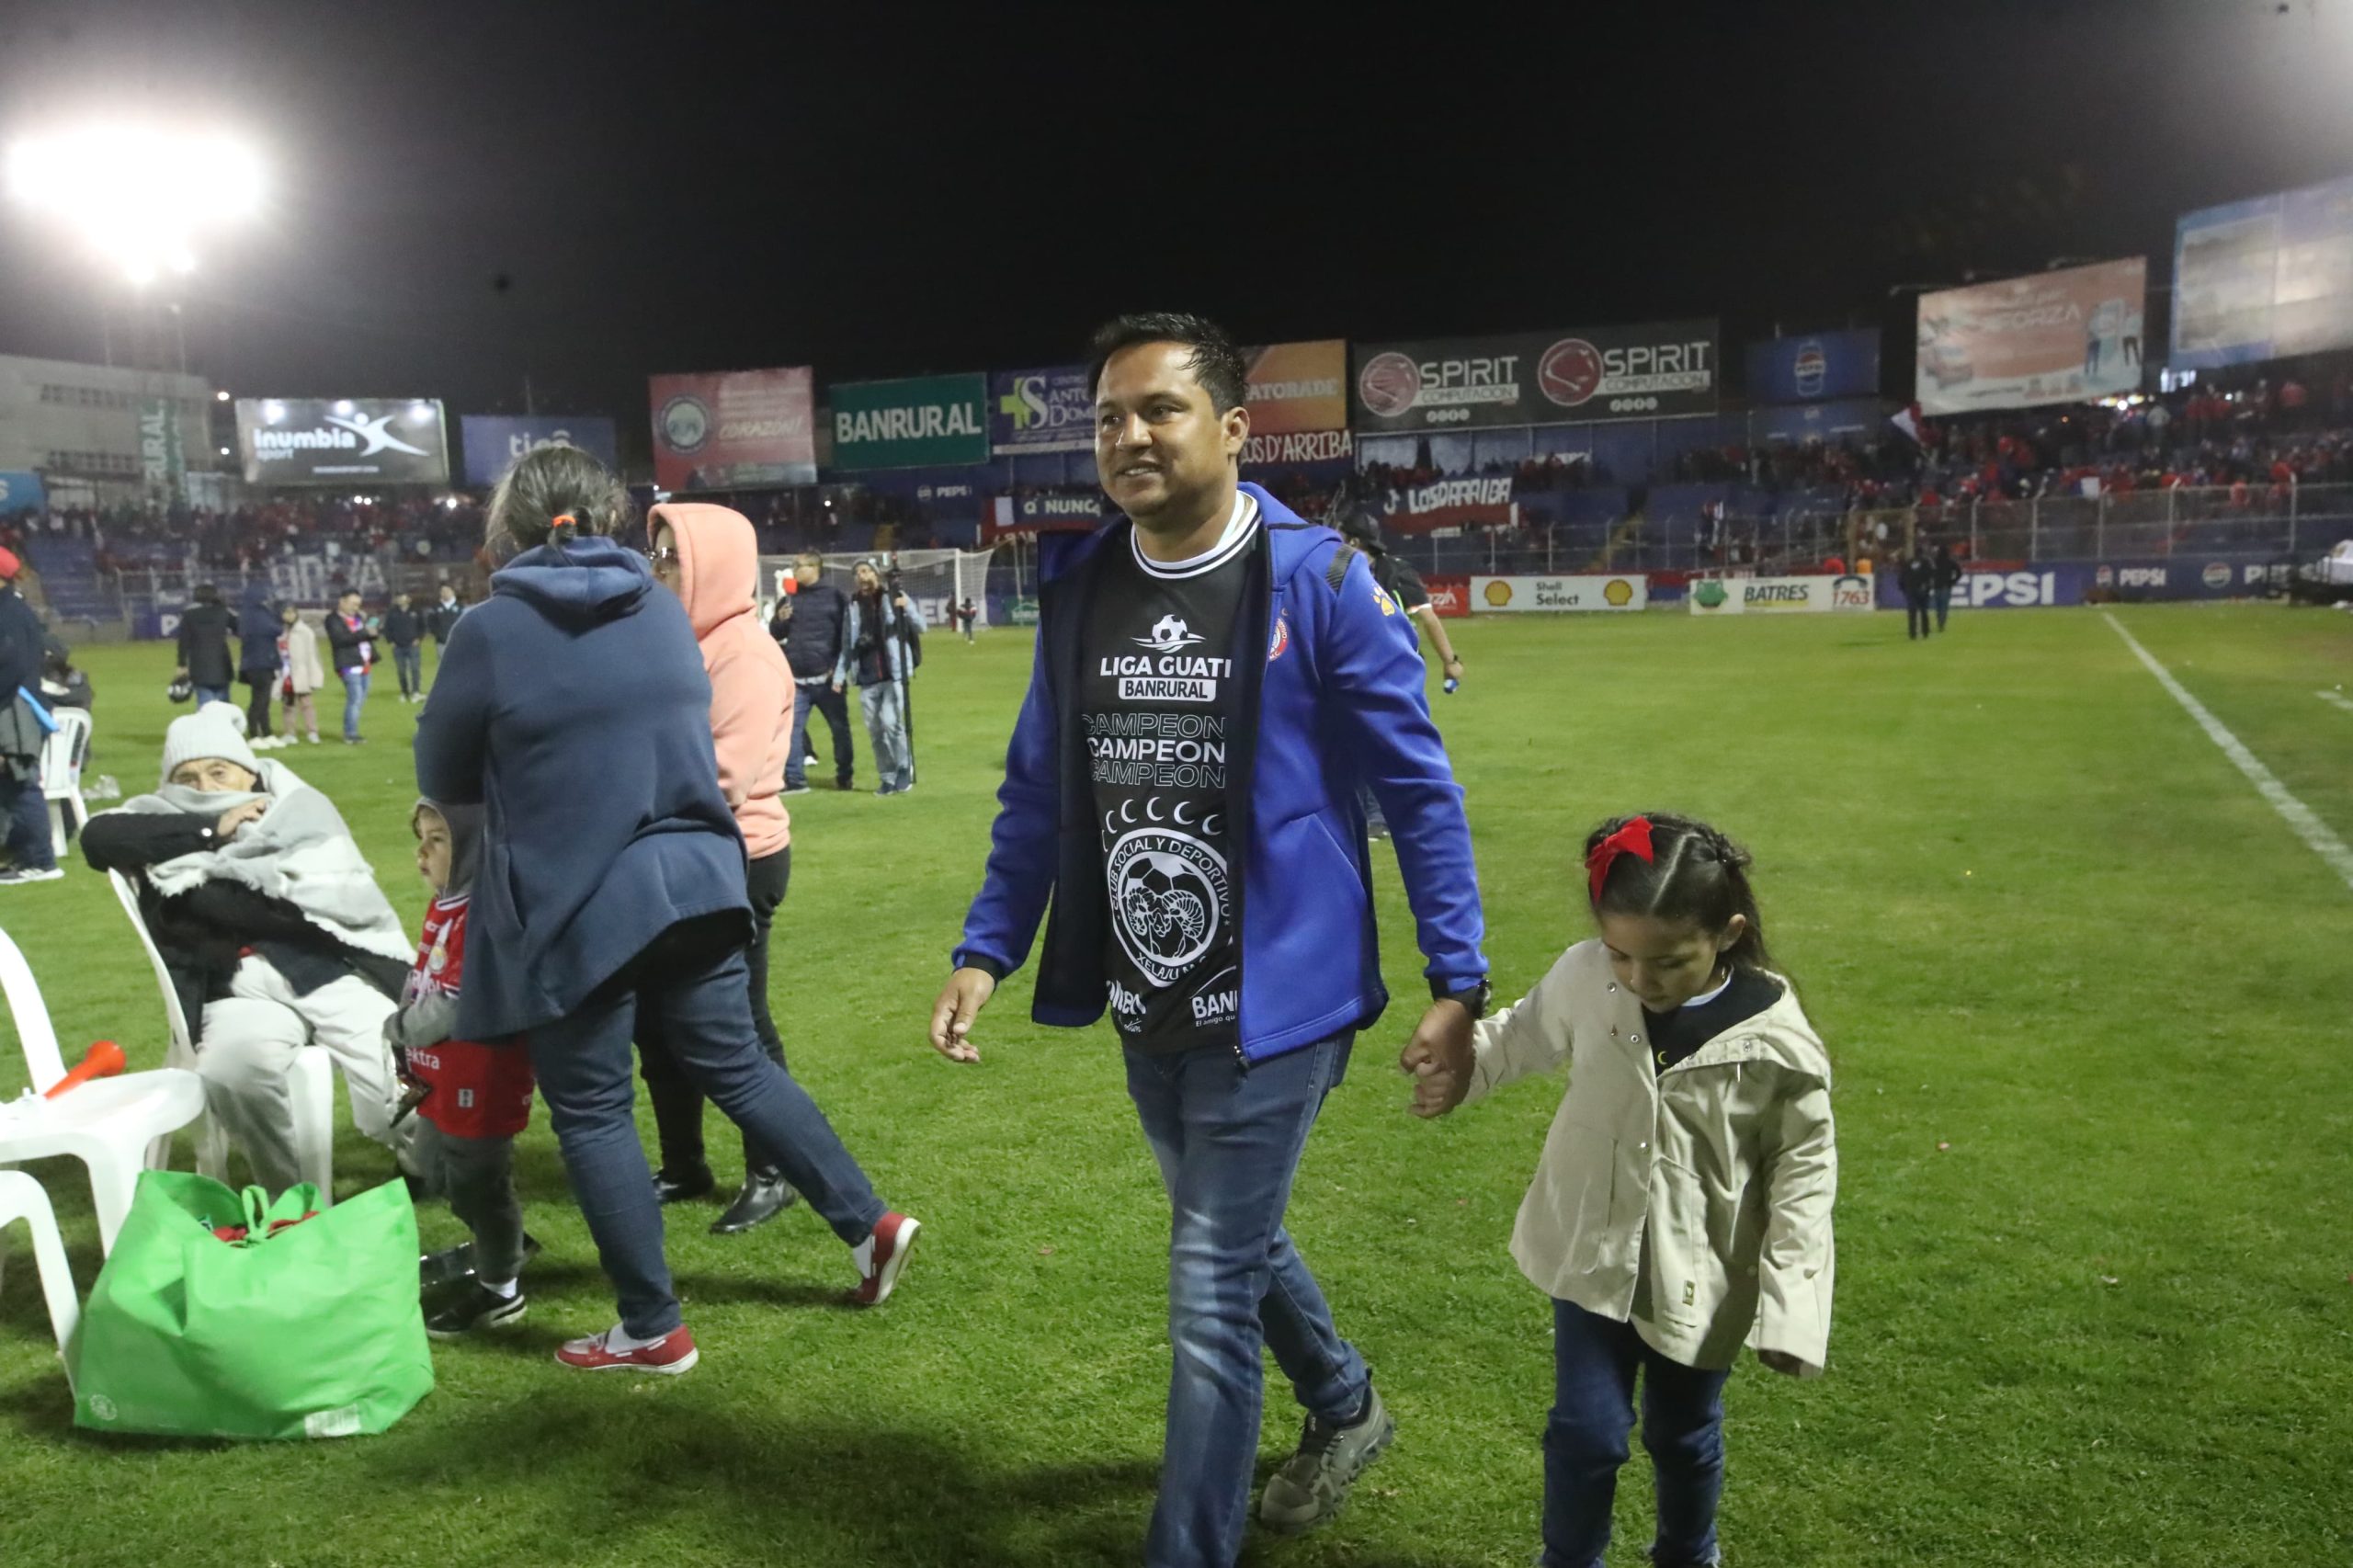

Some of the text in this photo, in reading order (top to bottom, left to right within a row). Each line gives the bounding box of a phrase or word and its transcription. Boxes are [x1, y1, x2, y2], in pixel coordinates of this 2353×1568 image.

[1604, 341, 1711, 377] SPIRIT
[1420, 356, 1519, 389] SPIRIT
[1245, 378, 1339, 401] ATORADE
[836, 403, 982, 443] BANRURAL
[937, 485, 972, 497] PEPSI
[1536, 582, 1563, 591] Shell
[2120, 567, 2166, 586] PEPSI
[1536, 593, 1580, 606] Select
[1744, 585, 1810, 602] BATRES
[1832, 589, 1870, 607] 1763
[1949, 571, 2056, 607] EPSI
[1100, 655, 1153, 677] LIGA
[1124, 679, 1208, 699] BANRURAL
[1082, 713, 1227, 739] CAMPEON
[1086, 736, 1226, 764] CAMPEON
[1090, 759, 1226, 789] CAMPEON
[1109, 837, 1230, 917] CLUB SOCIAL Y DEPORTIVO
[1202, 1016, 1223, 1027] amigo
[1225, 1014, 1235, 1022] qu
